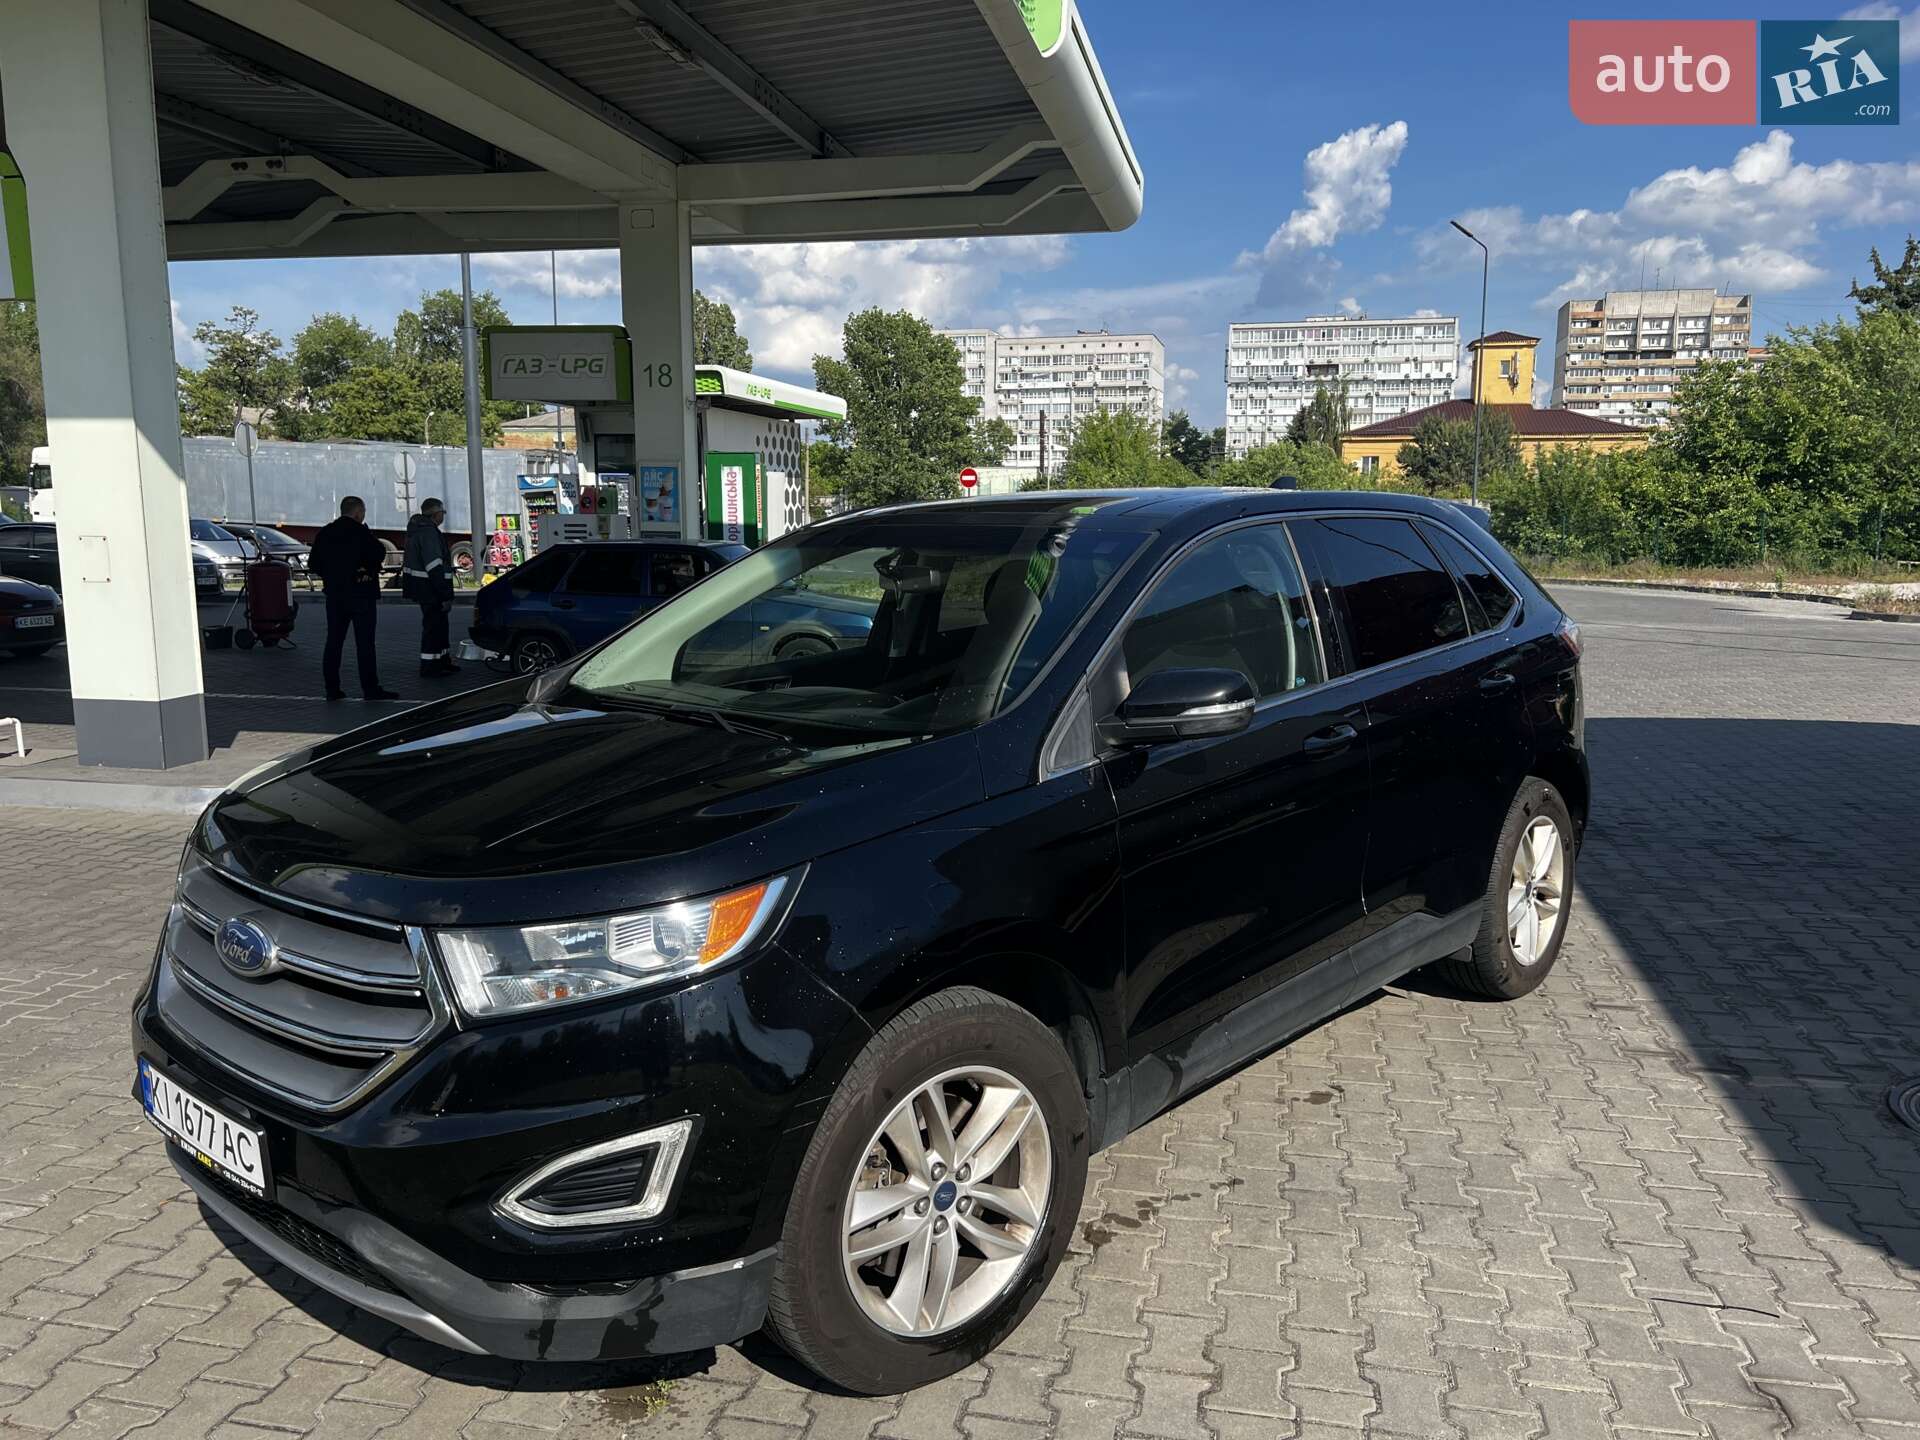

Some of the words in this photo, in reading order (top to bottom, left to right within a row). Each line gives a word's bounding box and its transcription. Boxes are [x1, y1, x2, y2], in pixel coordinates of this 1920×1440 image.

[643, 362, 673, 388] 18
[725, 471, 741, 543] оршинська
[222, 928, 254, 963] Ford
[150, 1071, 170, 1120] KI
[175, 1091, 217, 1150] 1677
[223, 1121, 255, 1173] AC
